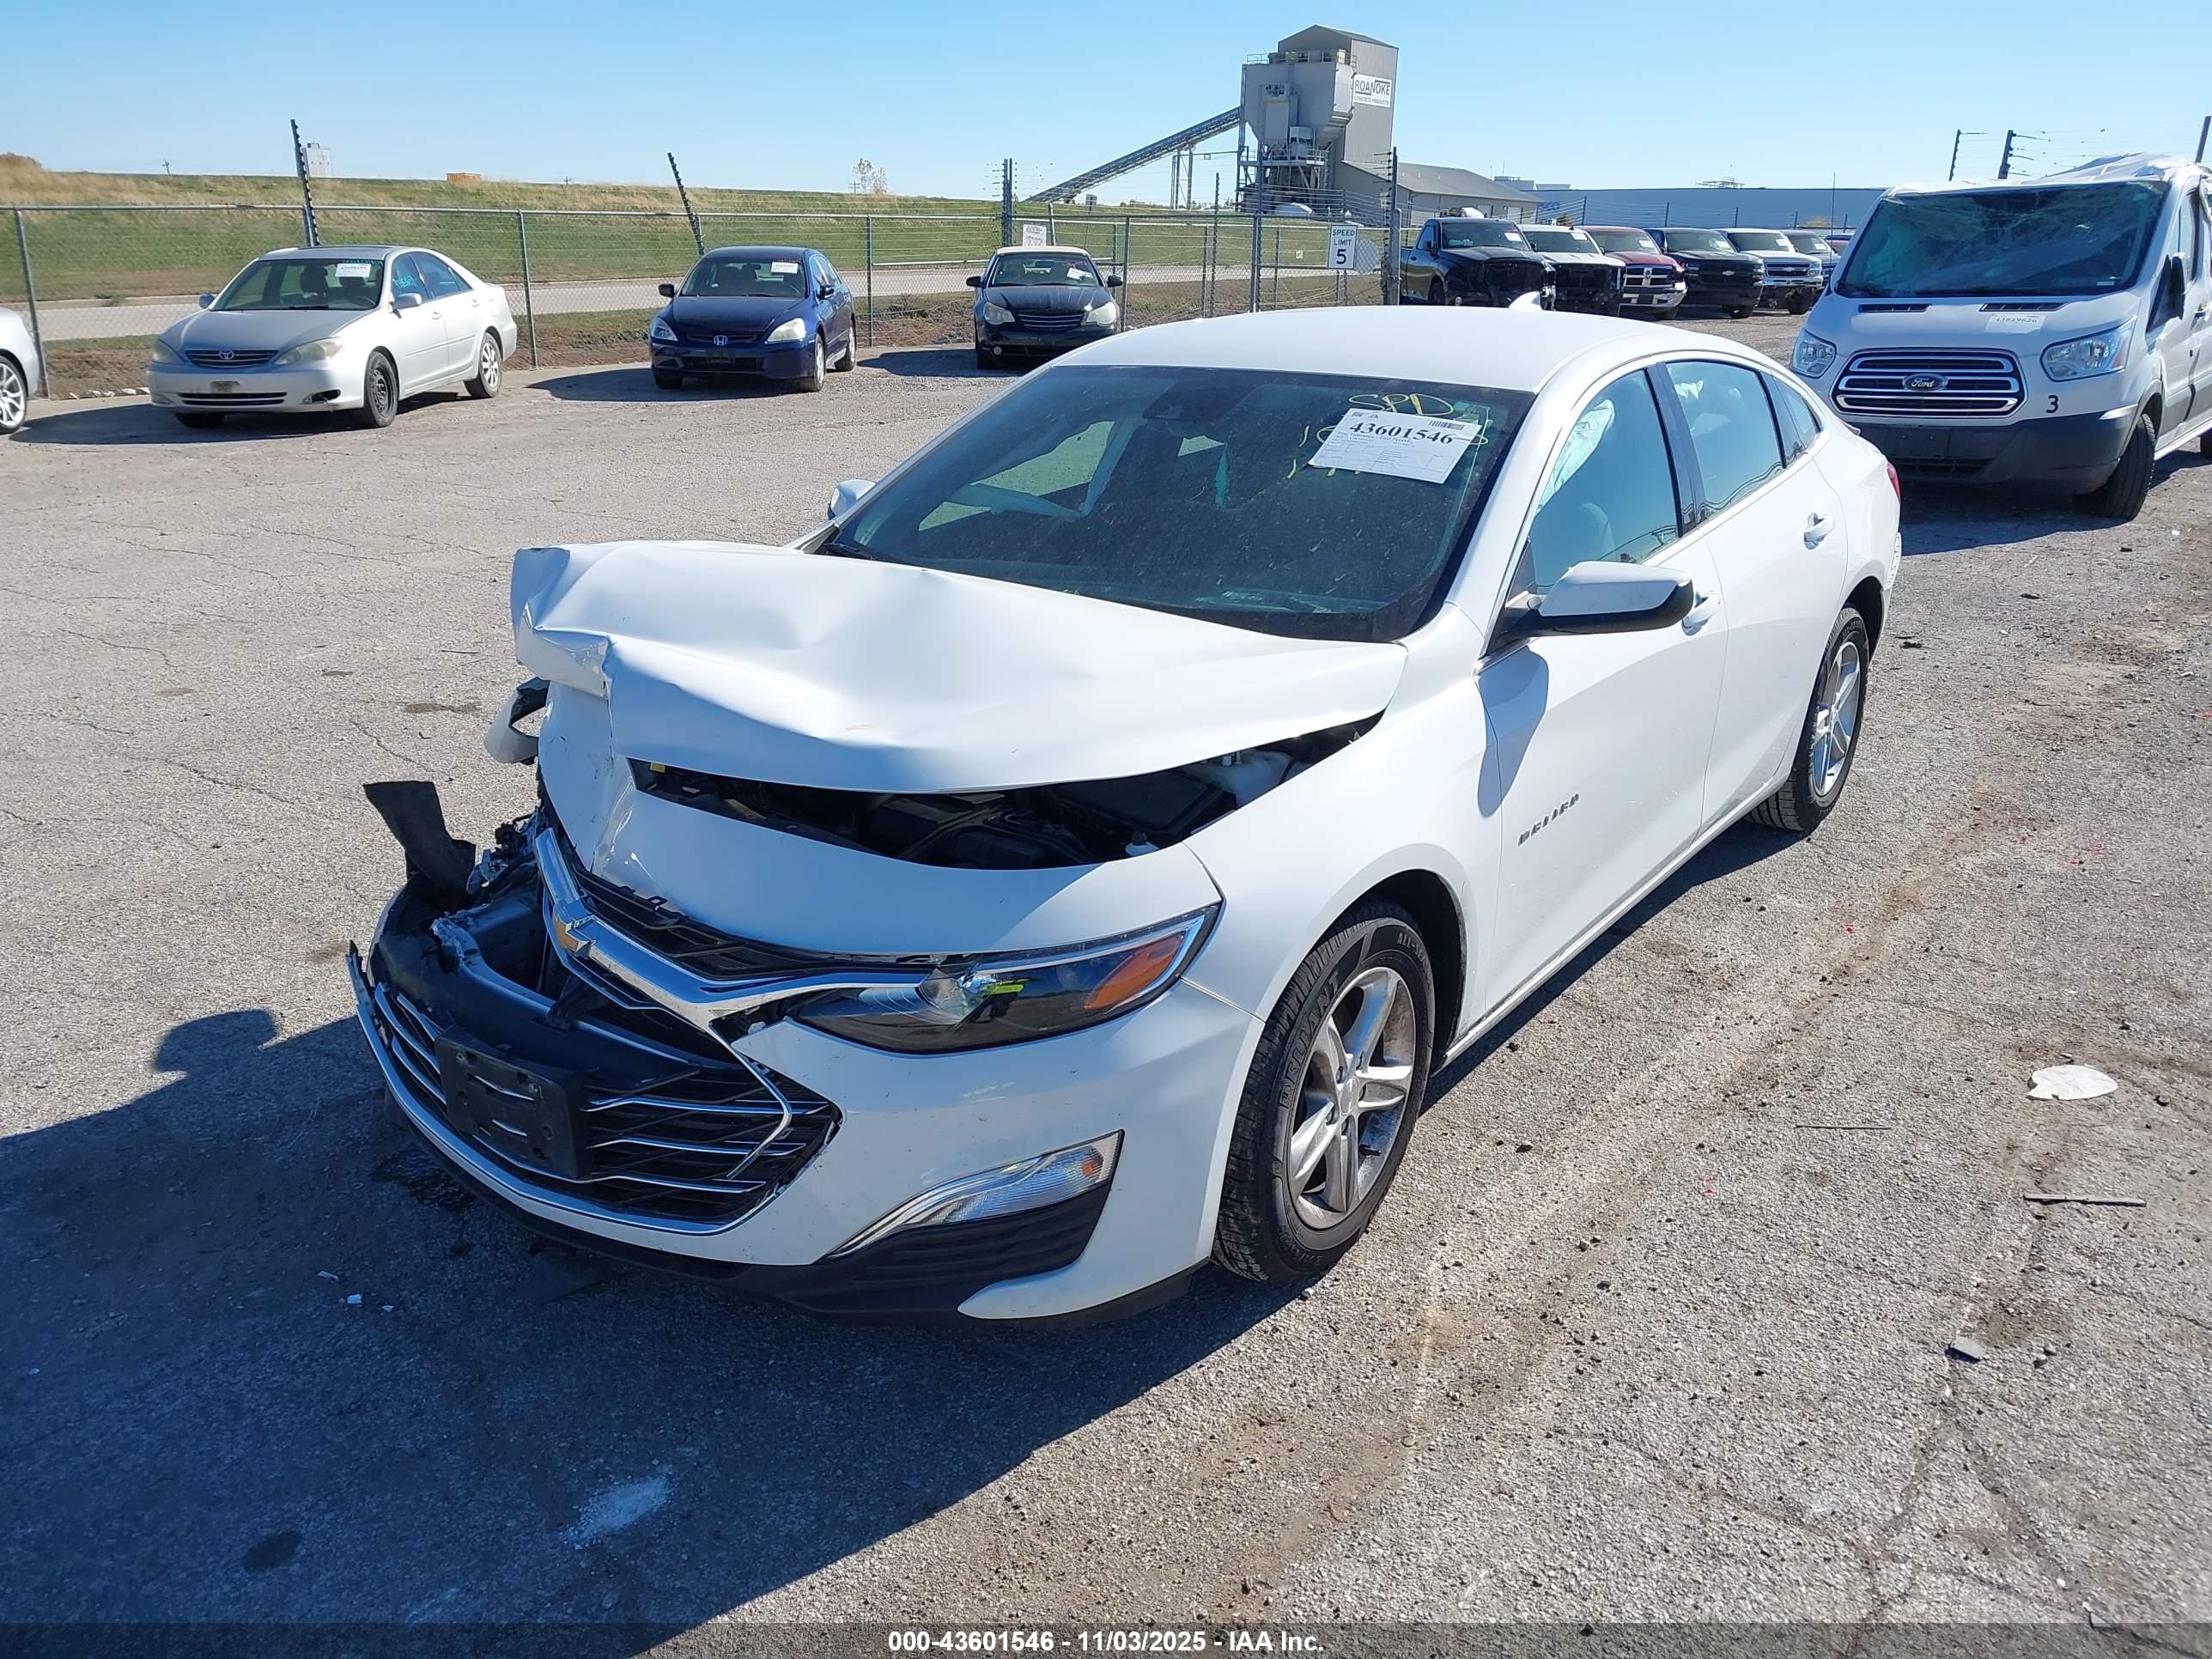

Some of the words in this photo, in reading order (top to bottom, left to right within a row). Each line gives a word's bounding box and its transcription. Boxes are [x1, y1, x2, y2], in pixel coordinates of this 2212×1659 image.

[1354, 79, 1391, 95] ROANOKE
[1336, 248, 1347, 264] 5
[1911, 377, 1936, 387] Ford
[2045, 394, 2059, 414] 3
[1349, 422, 1457, 446] 43601546
